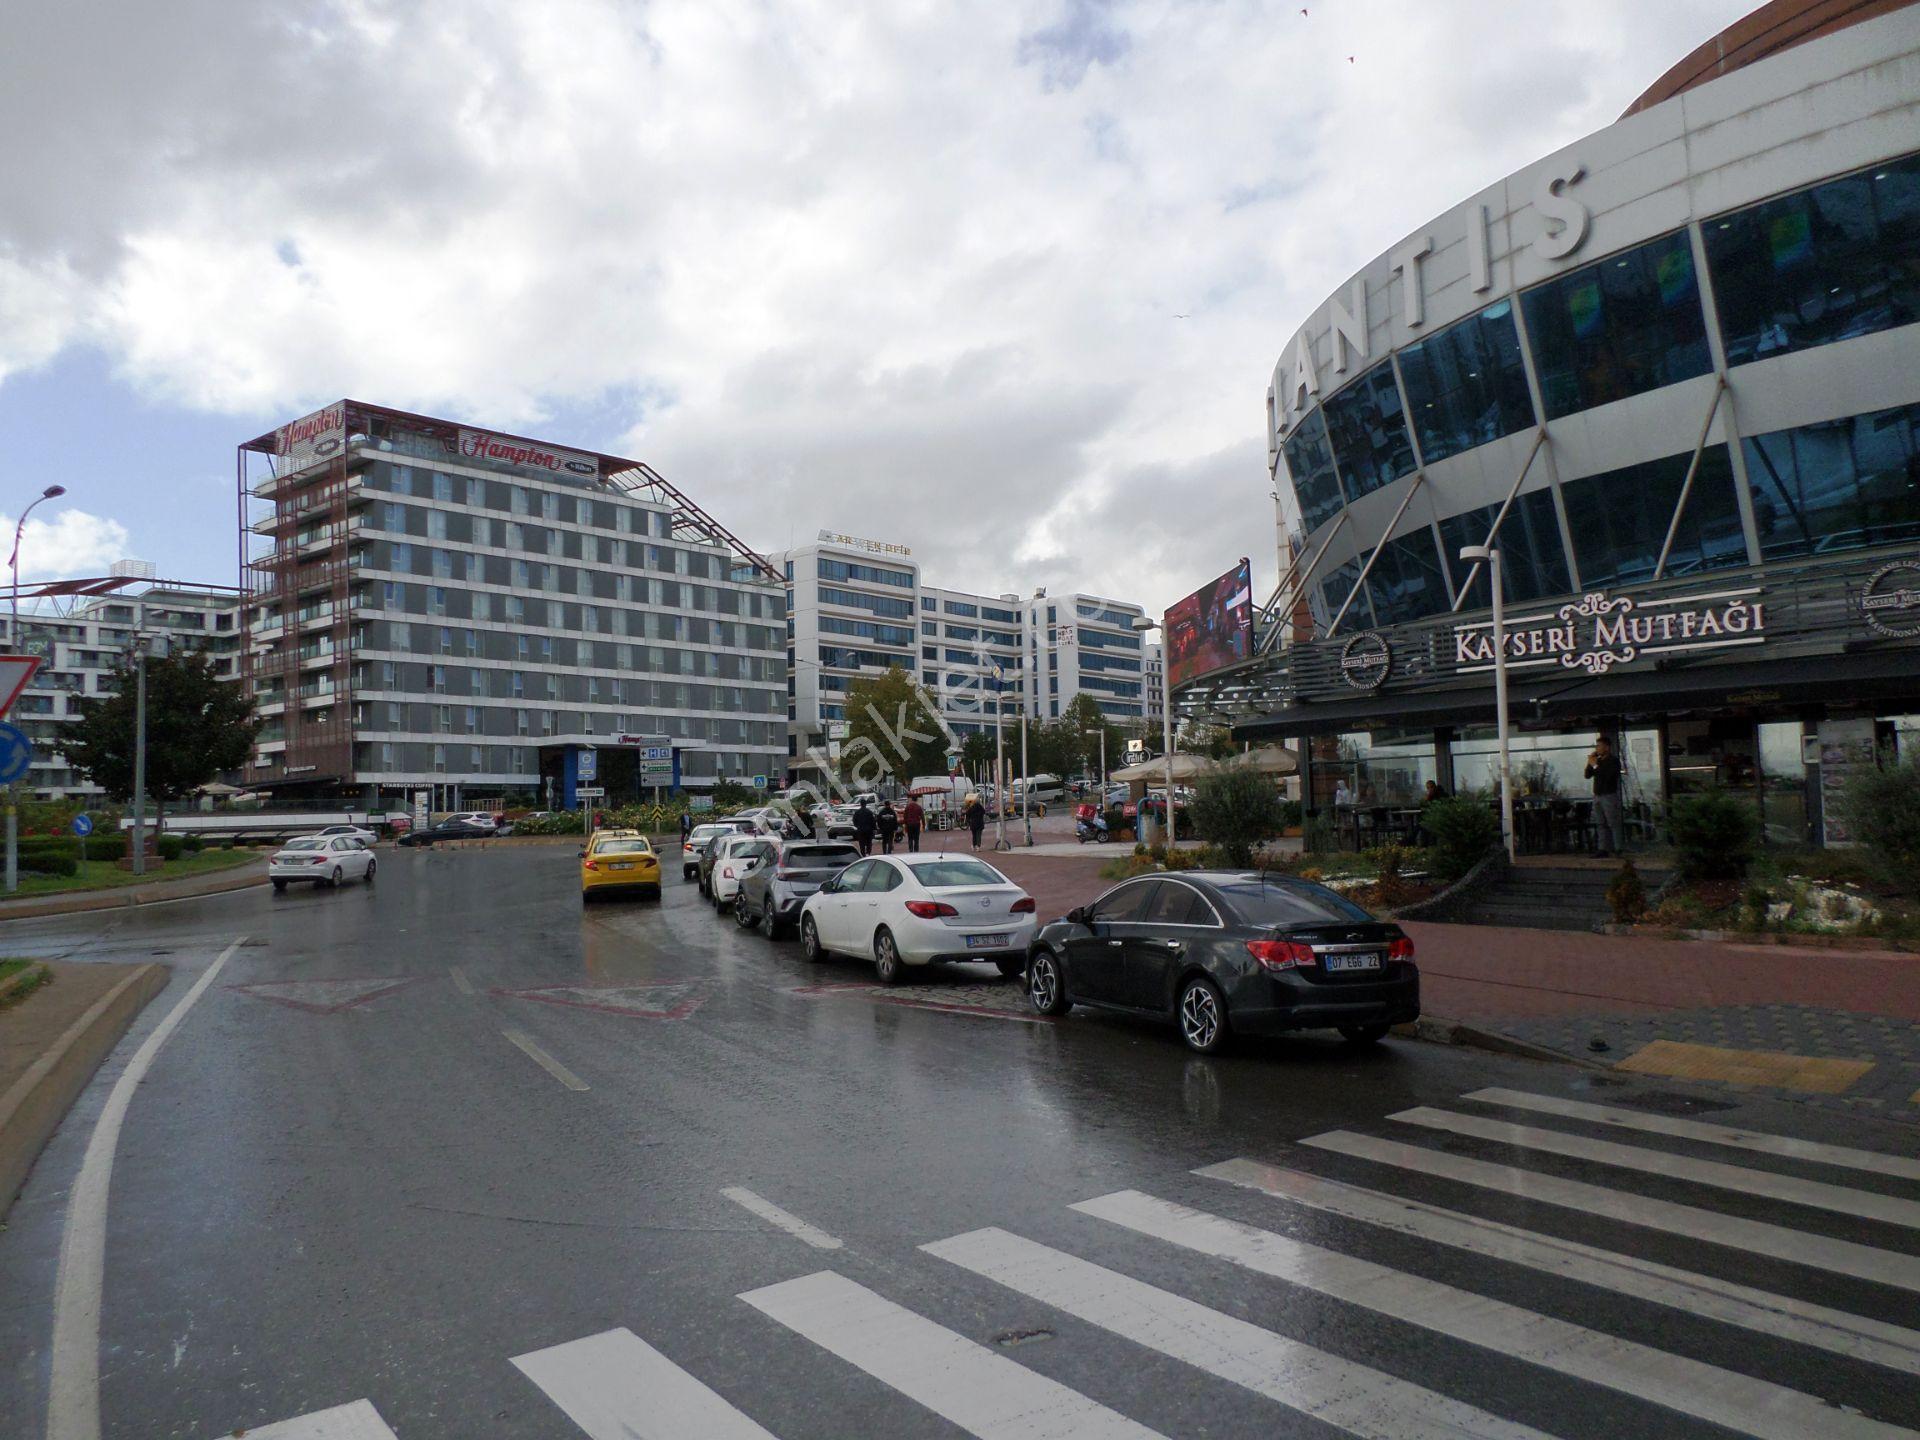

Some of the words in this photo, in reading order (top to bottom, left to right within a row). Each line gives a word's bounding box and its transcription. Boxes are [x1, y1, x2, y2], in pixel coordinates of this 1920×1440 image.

[463, 433, 561, 472] Hampton
[1594, 600, 1766, 648] MUTFAĞI
[1332, 958, 1342, 968] 07
[1368, 956, 1378, 967] 22
